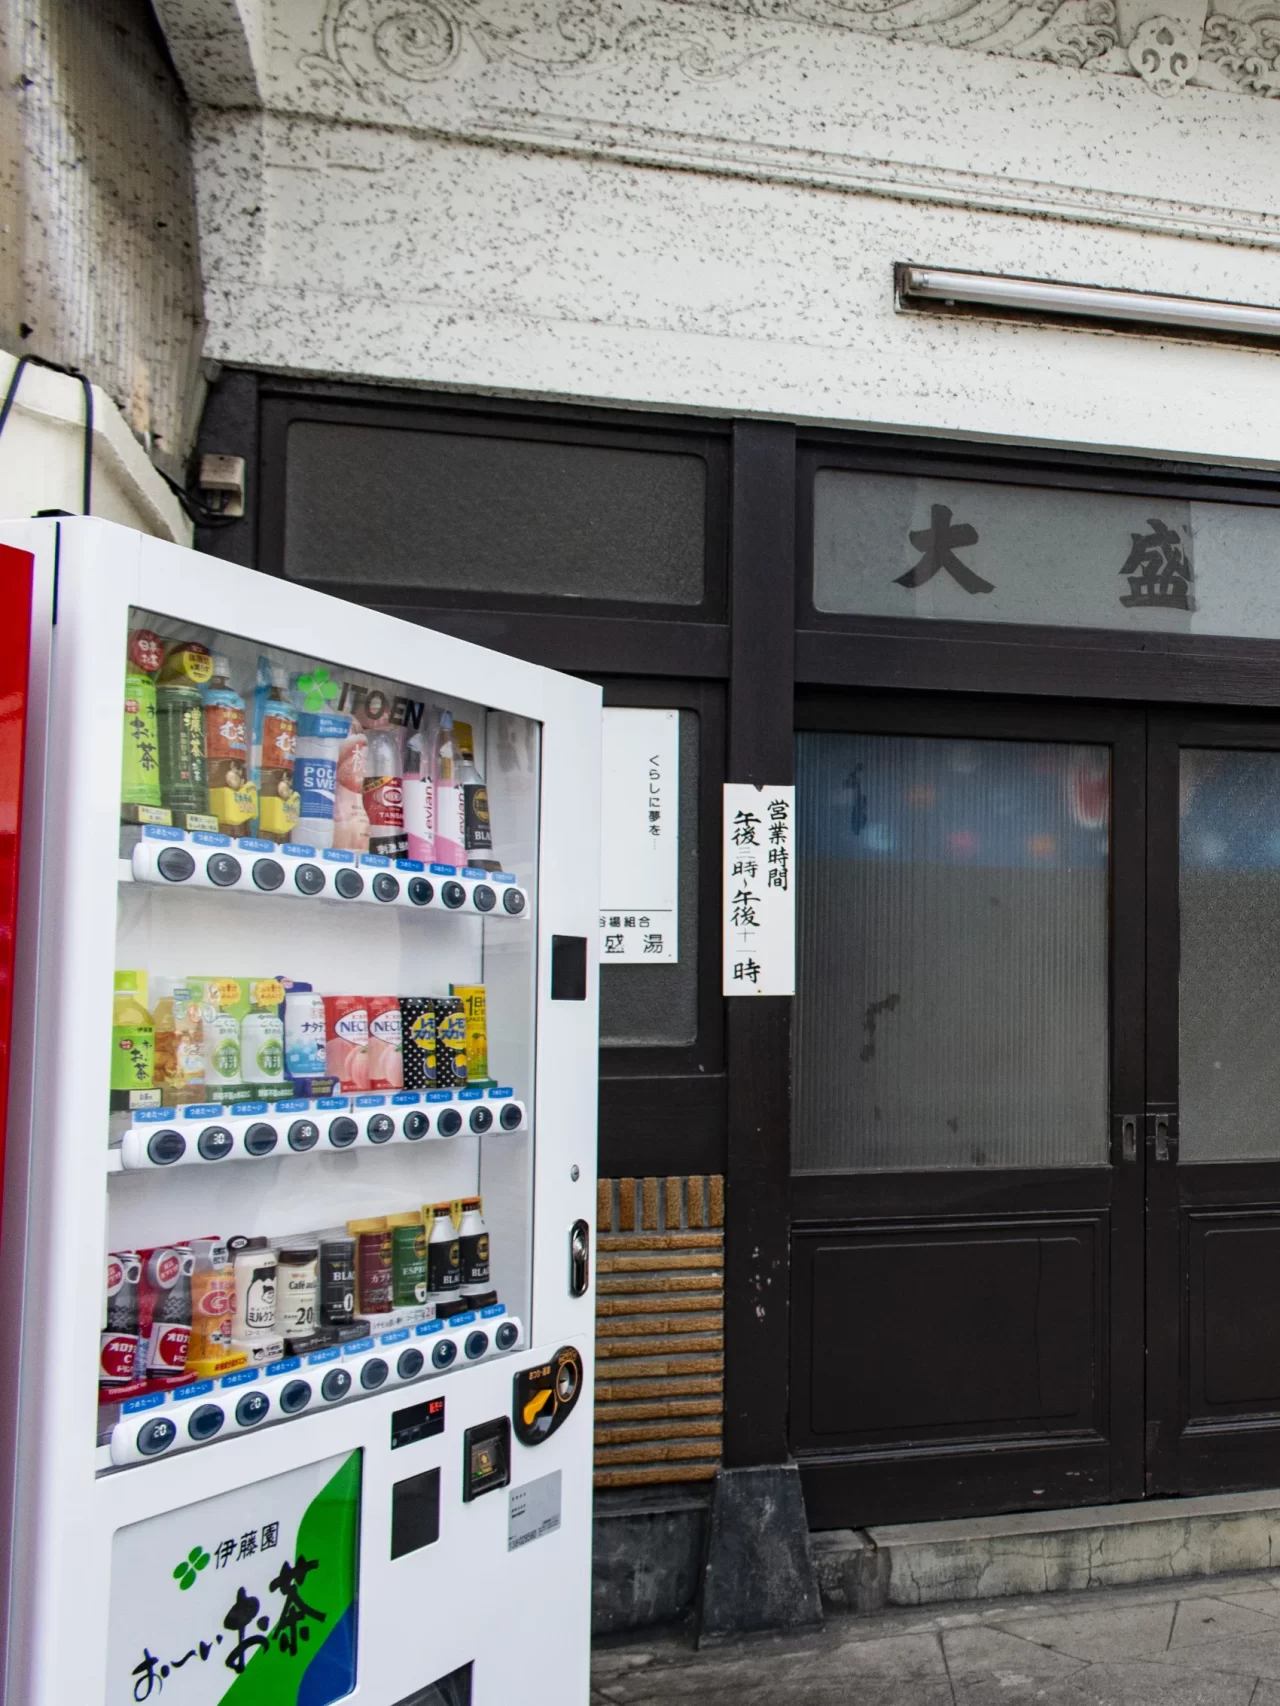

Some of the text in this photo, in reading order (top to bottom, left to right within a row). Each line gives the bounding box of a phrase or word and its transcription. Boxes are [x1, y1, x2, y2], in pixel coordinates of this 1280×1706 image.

[767, 799, 790, 891] 営業時間
[214, 1521, 279, 1569] 伊藤園
